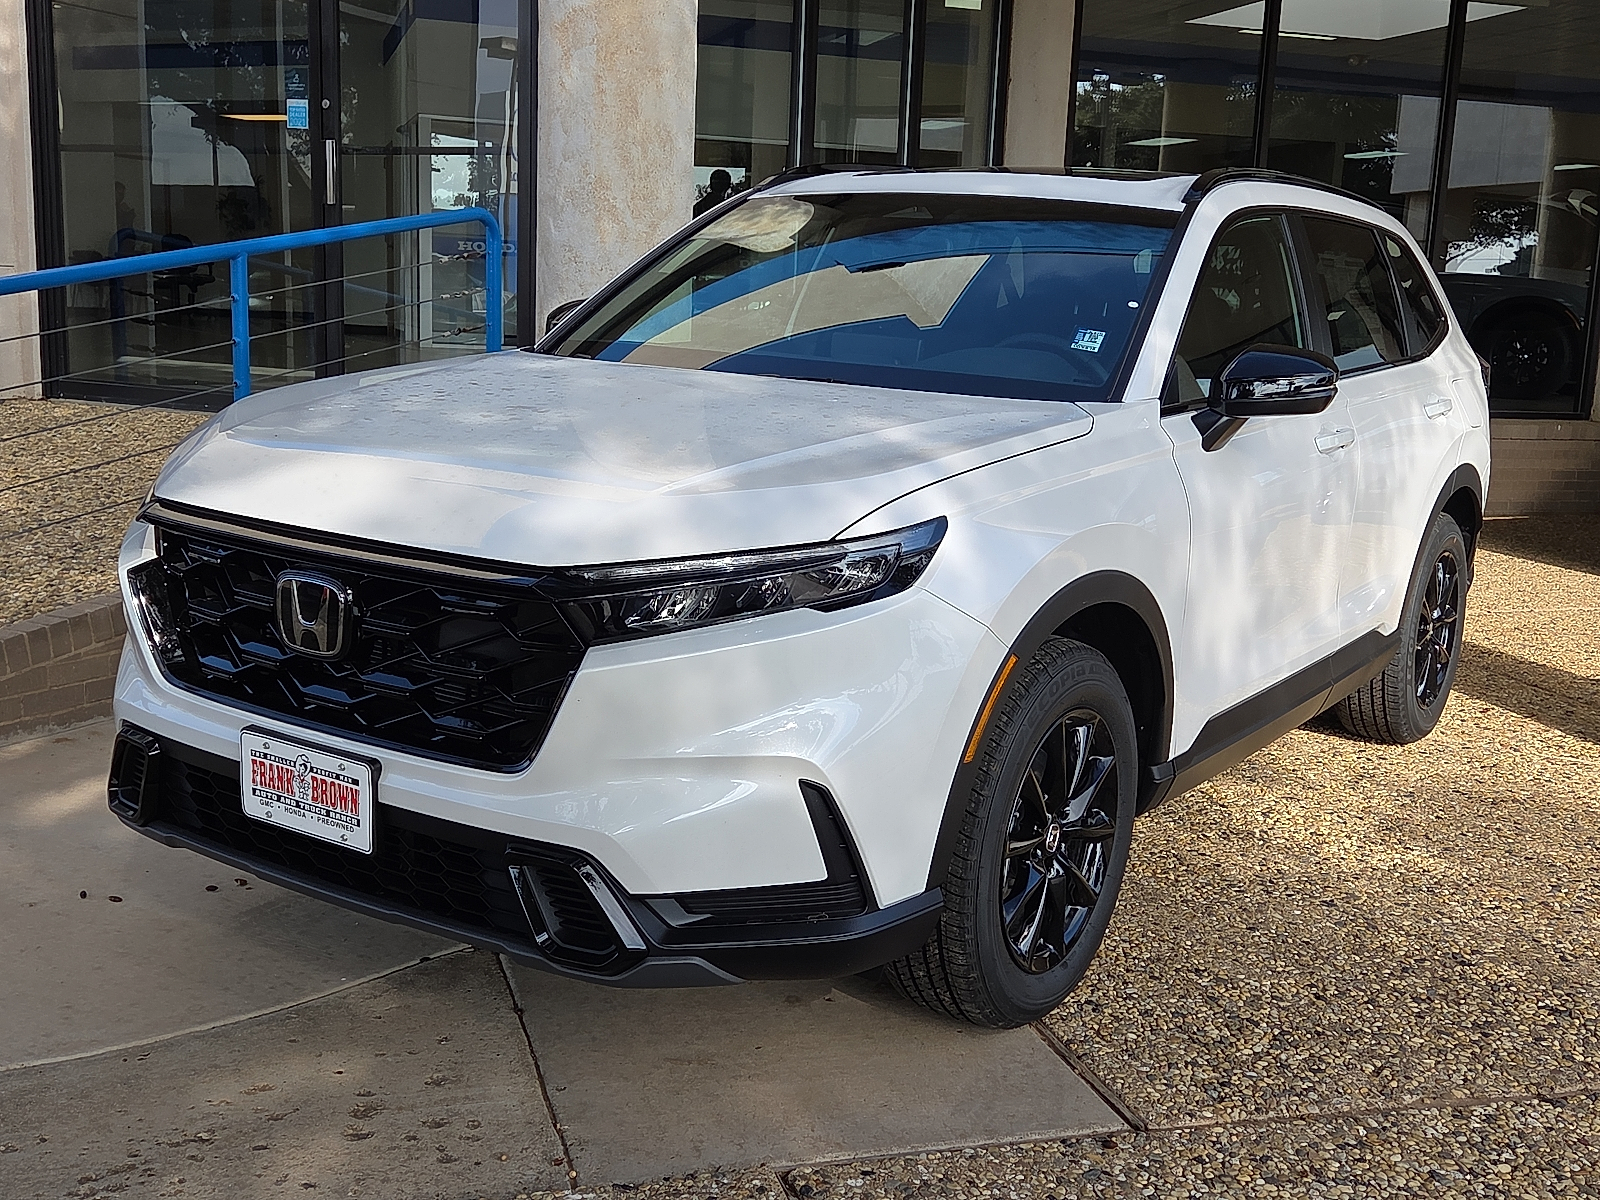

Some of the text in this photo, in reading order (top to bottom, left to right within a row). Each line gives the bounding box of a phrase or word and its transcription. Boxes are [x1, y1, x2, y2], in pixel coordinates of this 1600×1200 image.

[457, 240, 517, 253] HOD
[251, 750, 265, 759] THE
[266, 754, 295, 767] SMALLER
[312, 767, 337, 779] PROFIT
[251, 758, 360, 816] FRANK BROWN
[255, 789, 358, 826] AUTO AND TRUCK RANCH
[259, 799, 355, 833] GMC HONDA PREOWNED
